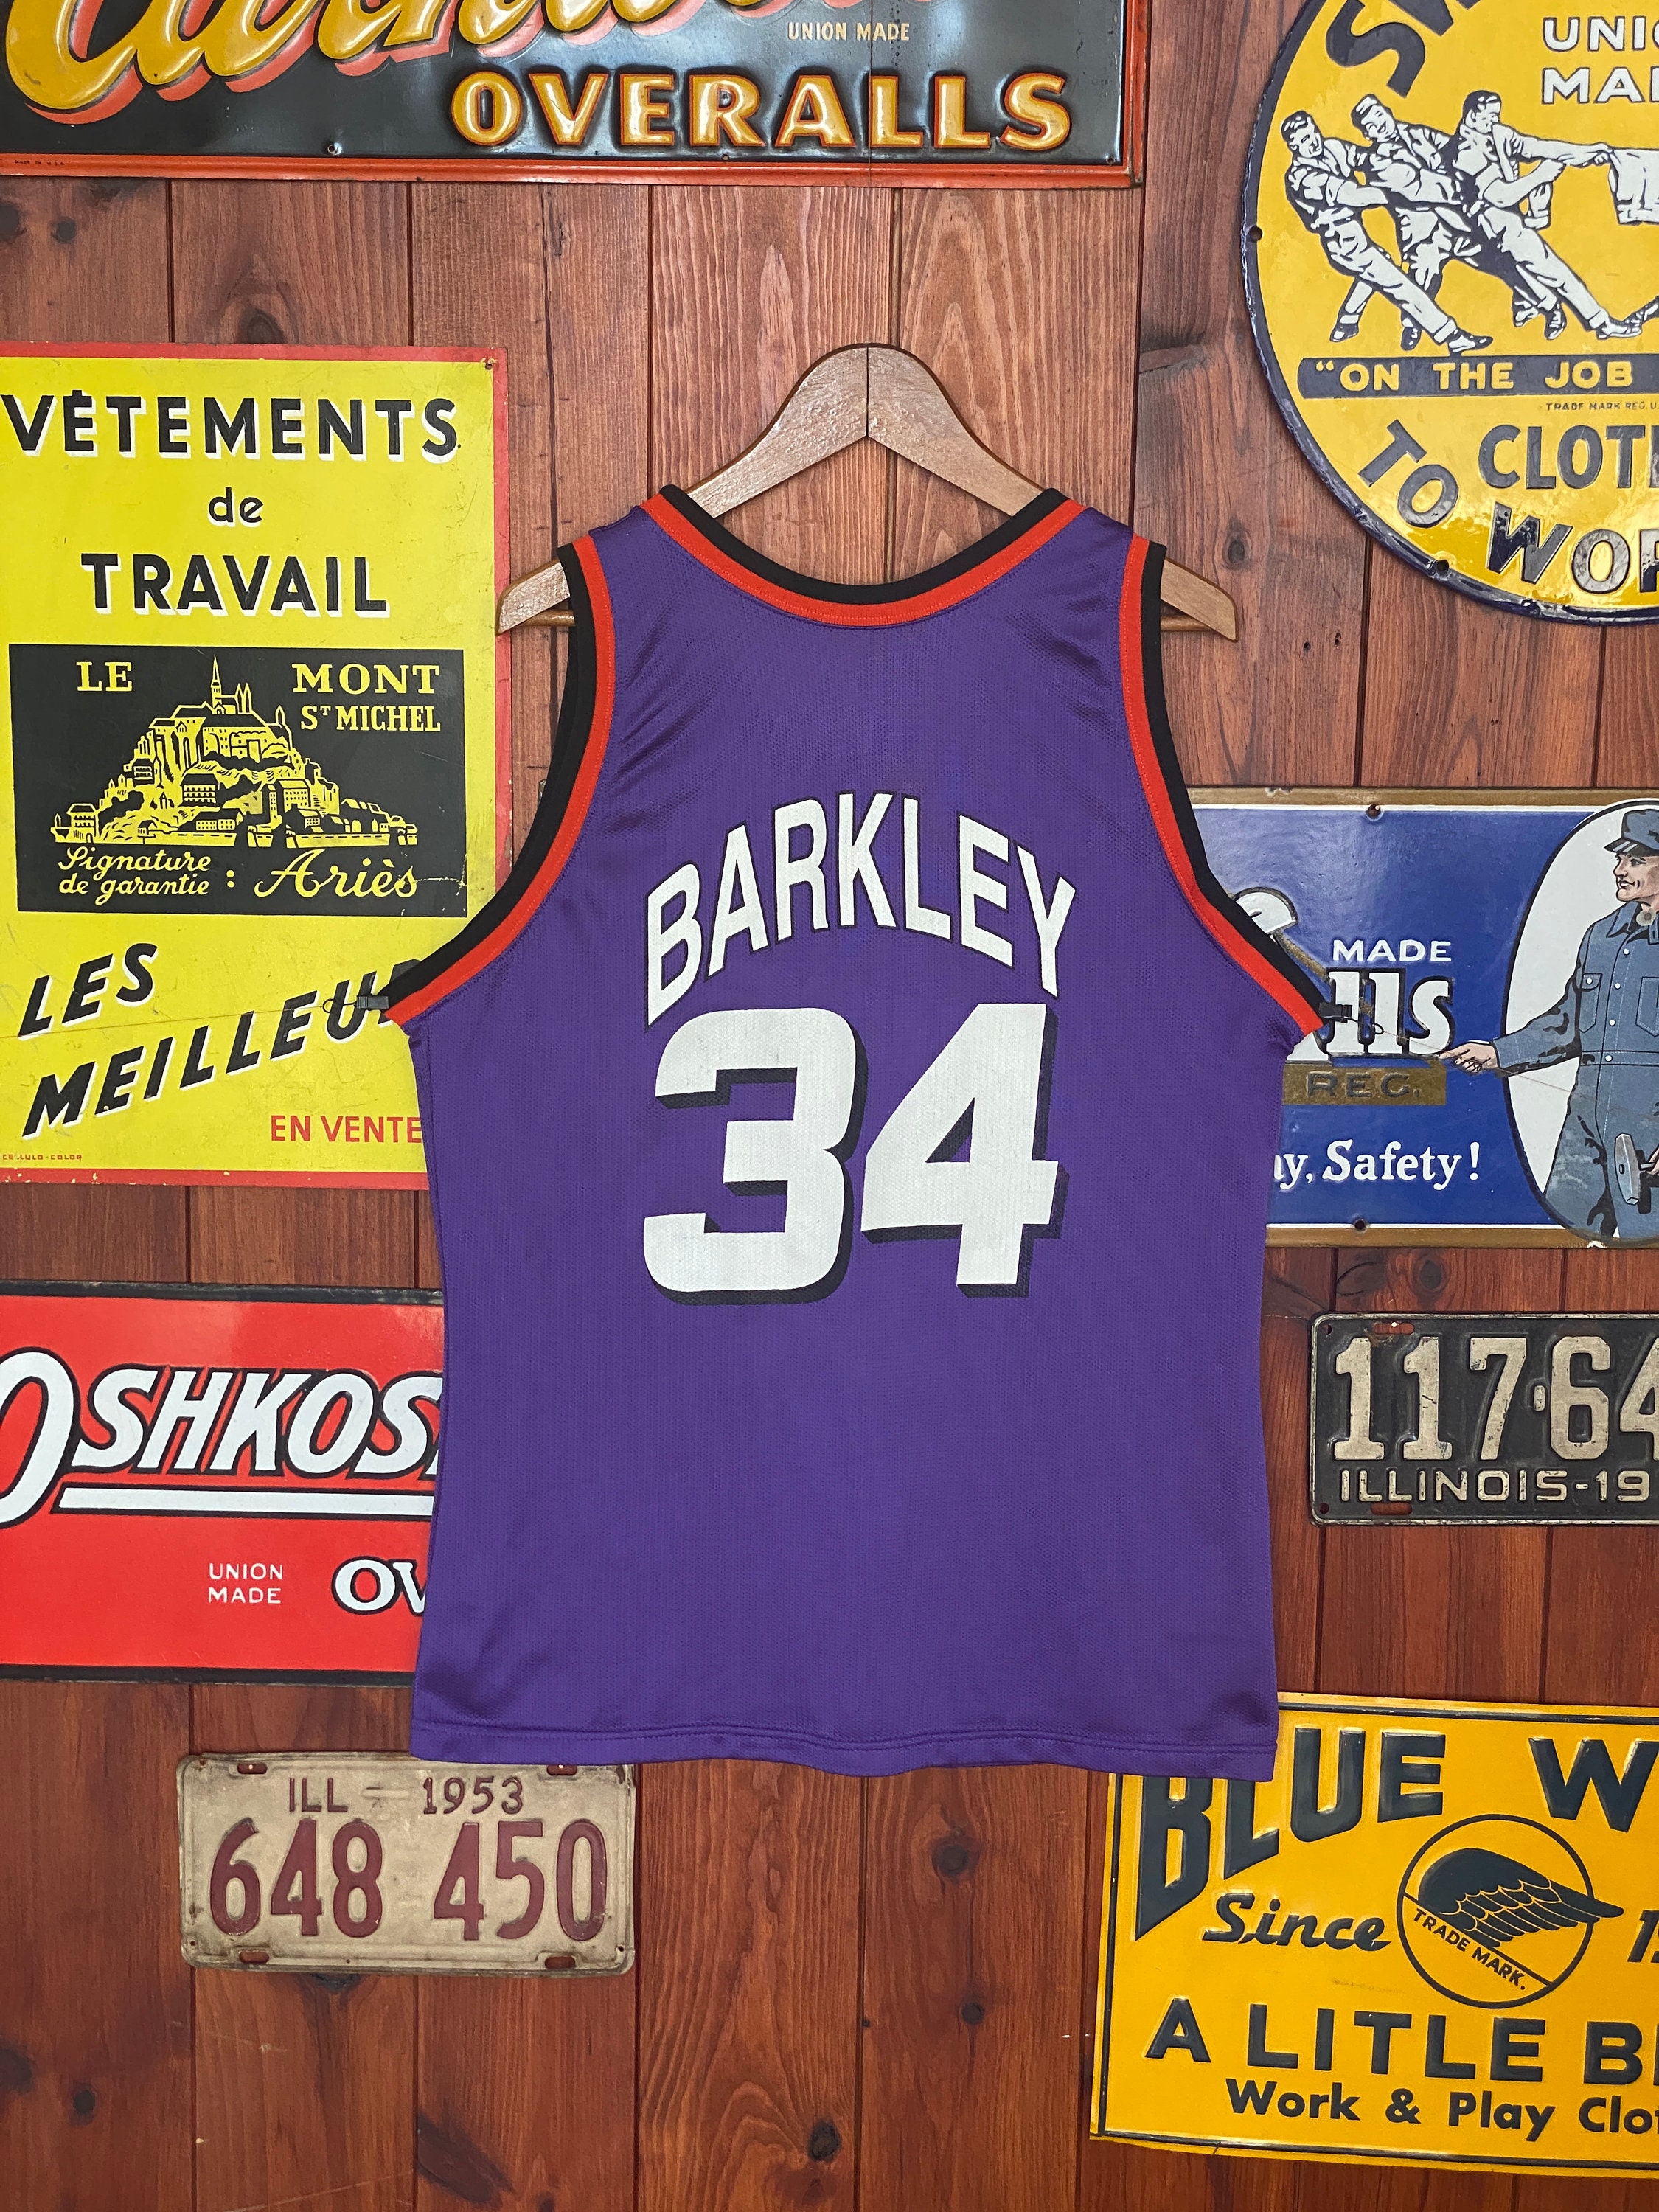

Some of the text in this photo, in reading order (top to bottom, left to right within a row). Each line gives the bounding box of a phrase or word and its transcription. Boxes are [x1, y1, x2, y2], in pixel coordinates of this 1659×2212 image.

[788, 21, 910, 41] UNION MADE
[1543, 16, 1659, 52] UNI
[1542, 66, 1659, 105] MA
[451, 72, 1071, 150] OVERALLS
[1433, 362, 1514, 390] THE
[1545, 361, 1632, 389] JOB
[1589, 402, 1621, 410] MARK
[1357, 419, 1460, 529] TO
[1478, 424, 1659, 490] CLOT
[207, 487, 264, 527] de
[80, 554, 391, 618] TRAVAIL
[76, 661, 440, 695] LE MONT
[335, 706, 440, 732] MICHEL
[58, 846, 211, 880] Signature
[58, 877, 88, 894] de
[96, 876, 209, 905] garantie
[254, 849, 419, 899] Ariès
[645, 790, 1077, 1031] BARKLEY
[1333, 939, 1452, 962] MADE
[18, 942, 159, 1039] LES
[1306, 1071, 1420, 1098] REG.
[271, 1116, 422, 1143] EN VENTE
[643, 1004, 1070, 1305] 34
[0, 1346, 443, 1528] OSHKOS
[208, 1587, 281, 1604] MADE
[209, 1562, 283, 1581] UNION
[288, 1775, 524, 1815] ILL 1953
[1134, 1727, 1447, 1942] BLUE
[209, 1817, 608, 1942] 648 450
[1203, 1893, 1391, 1952] Since
[1413, 1907, 1526, 1991] TRADE MARK.
[1144, 1997, 1211, 2064] A
[1246, 2003, 1547, 2082] LITLE
[1225, 2078, 1361, 2122] Work
[1385, 2089, 1422, 2125] &
[1448, 2091, 1556, 2142] Play
